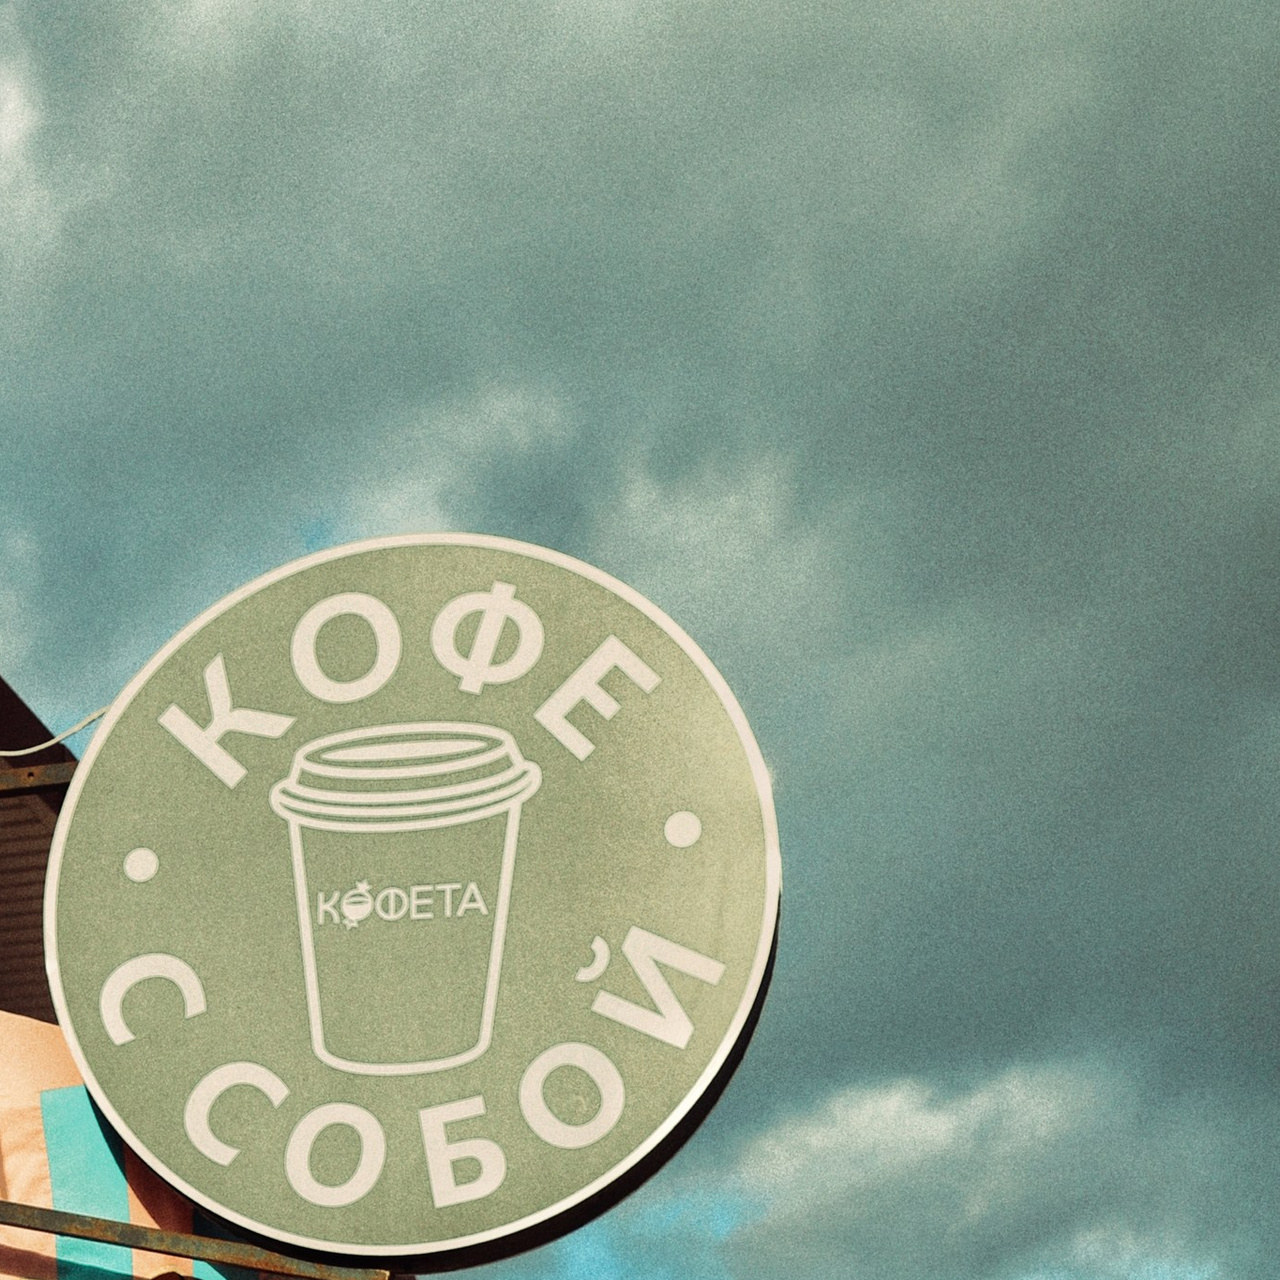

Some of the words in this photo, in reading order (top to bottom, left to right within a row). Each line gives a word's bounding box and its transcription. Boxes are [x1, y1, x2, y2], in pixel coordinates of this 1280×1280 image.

[157, 580, 662, 789] КОФЕ
[316, 880, 489, 931] КОФЕТА
[99, 952, 208, 1046] С
[183, 925, 726, 1209] СОБОЙ
